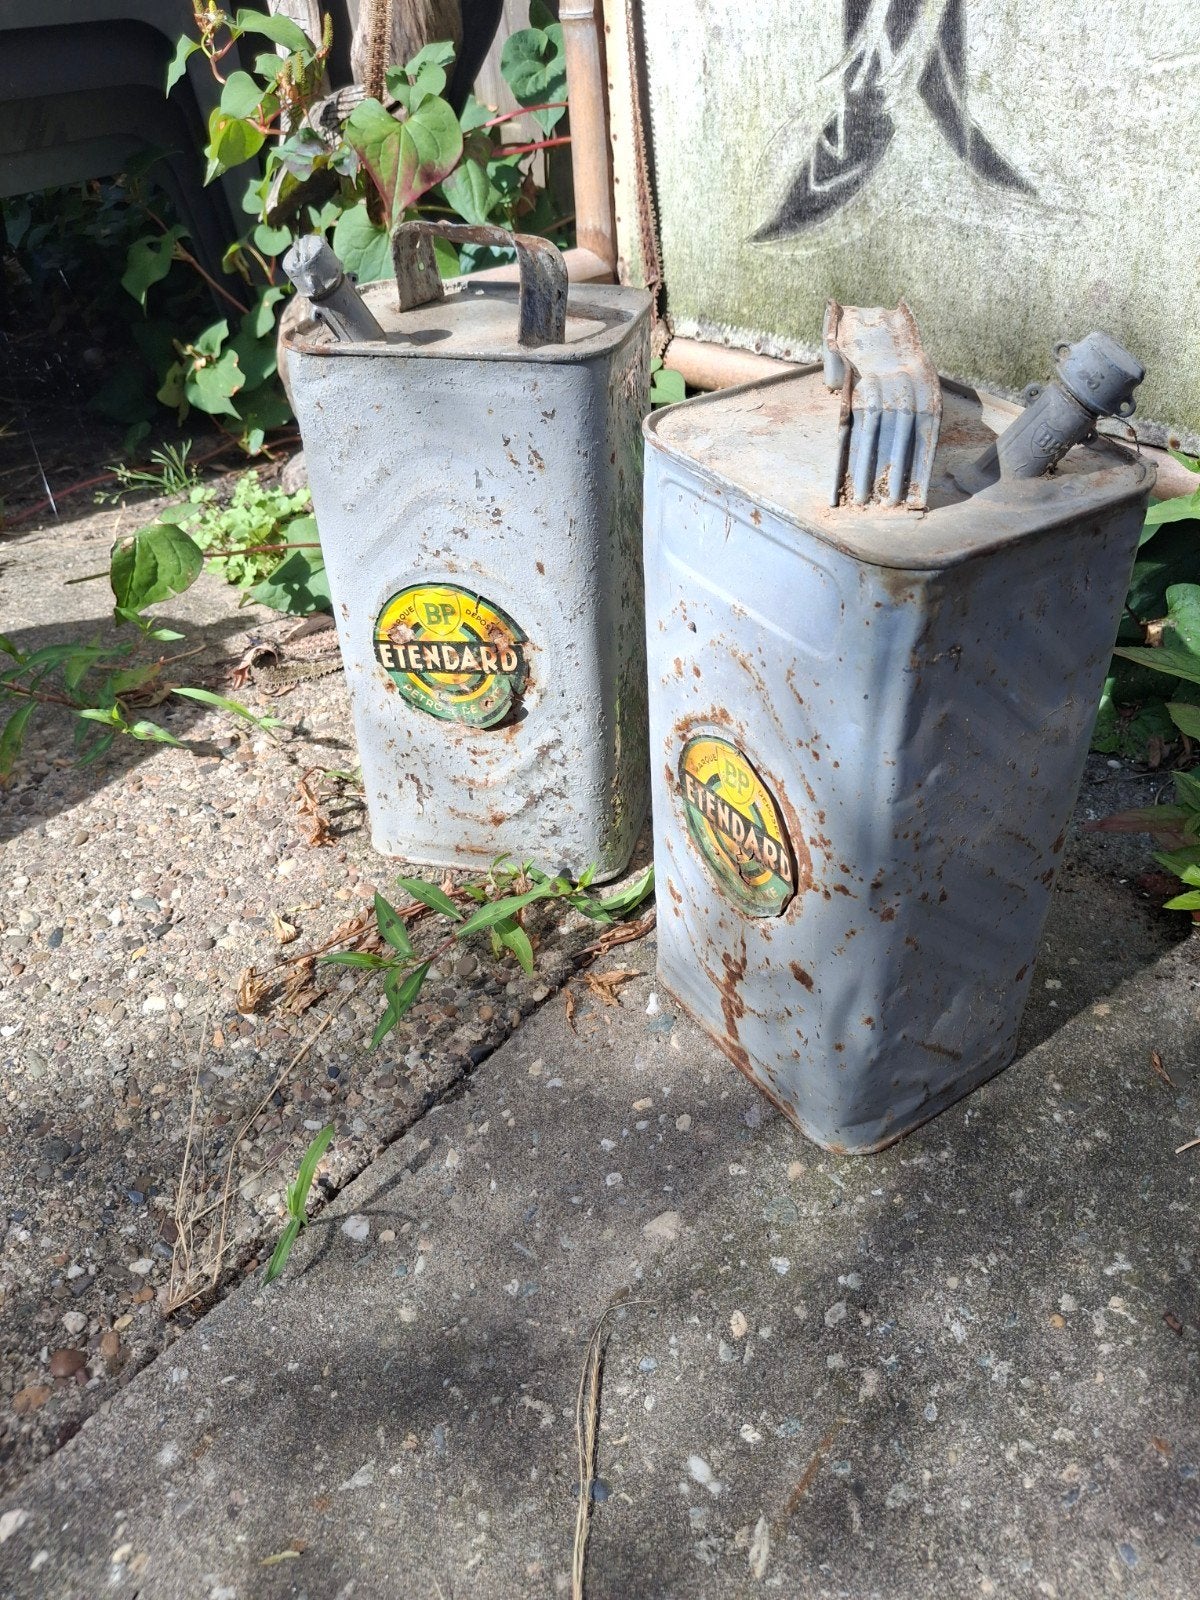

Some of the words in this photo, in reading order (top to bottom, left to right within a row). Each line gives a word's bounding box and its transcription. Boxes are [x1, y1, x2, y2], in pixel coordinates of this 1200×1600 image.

[395, 605, 415, 625] RQUE
[423, 603, 456, 625] BP
[379, 643, 518, 674] ETENDARD
[725, 758, 750, 796] BP
[685, 776, 792, 883] ETENDARD
